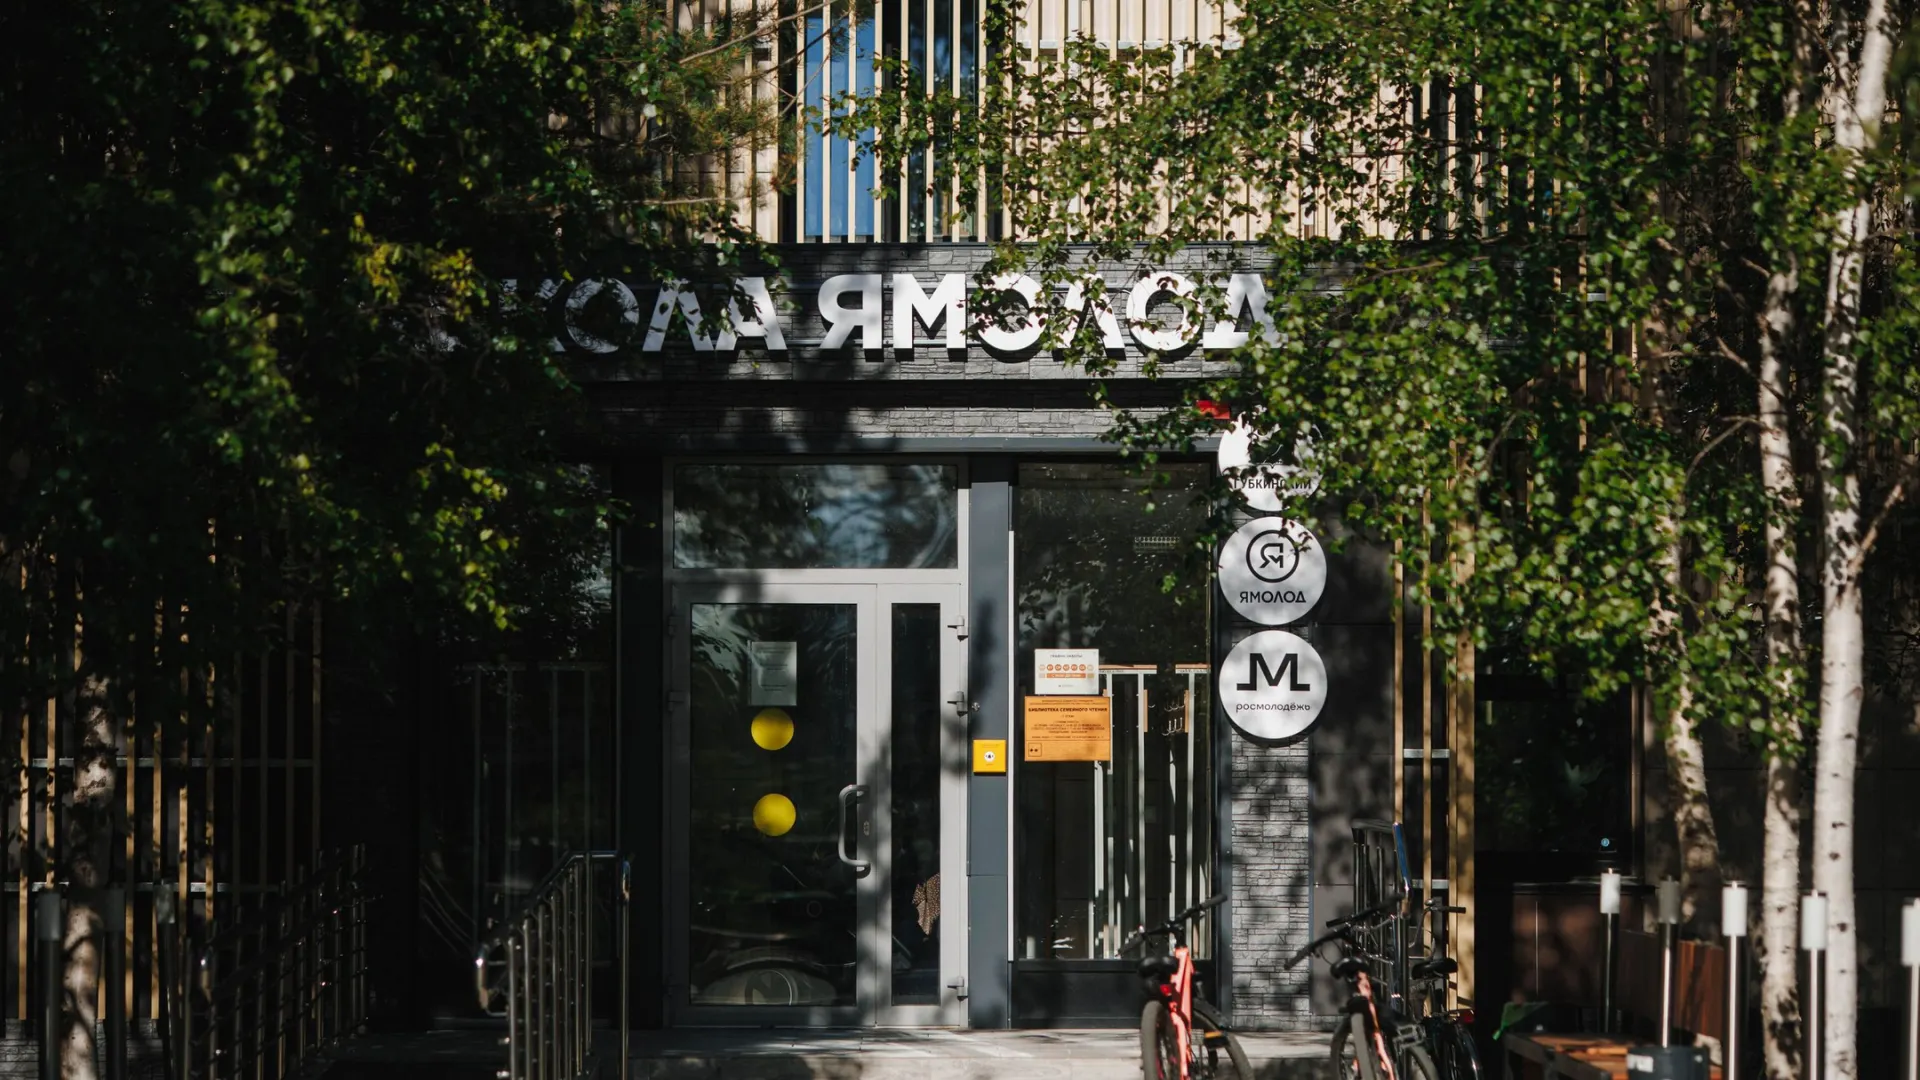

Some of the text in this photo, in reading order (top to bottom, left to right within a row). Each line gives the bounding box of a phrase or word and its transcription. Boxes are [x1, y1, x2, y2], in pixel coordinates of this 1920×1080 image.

[388, 271, 1284, 354] КОЛА ЯМОЛОД
[1233, 477, 1312, 489] ГУБКИНСИЙ
[1239, 590, 1307, 604] ЯМОЛОД
[1235, 702, 1312, 713] росмолодёжь
